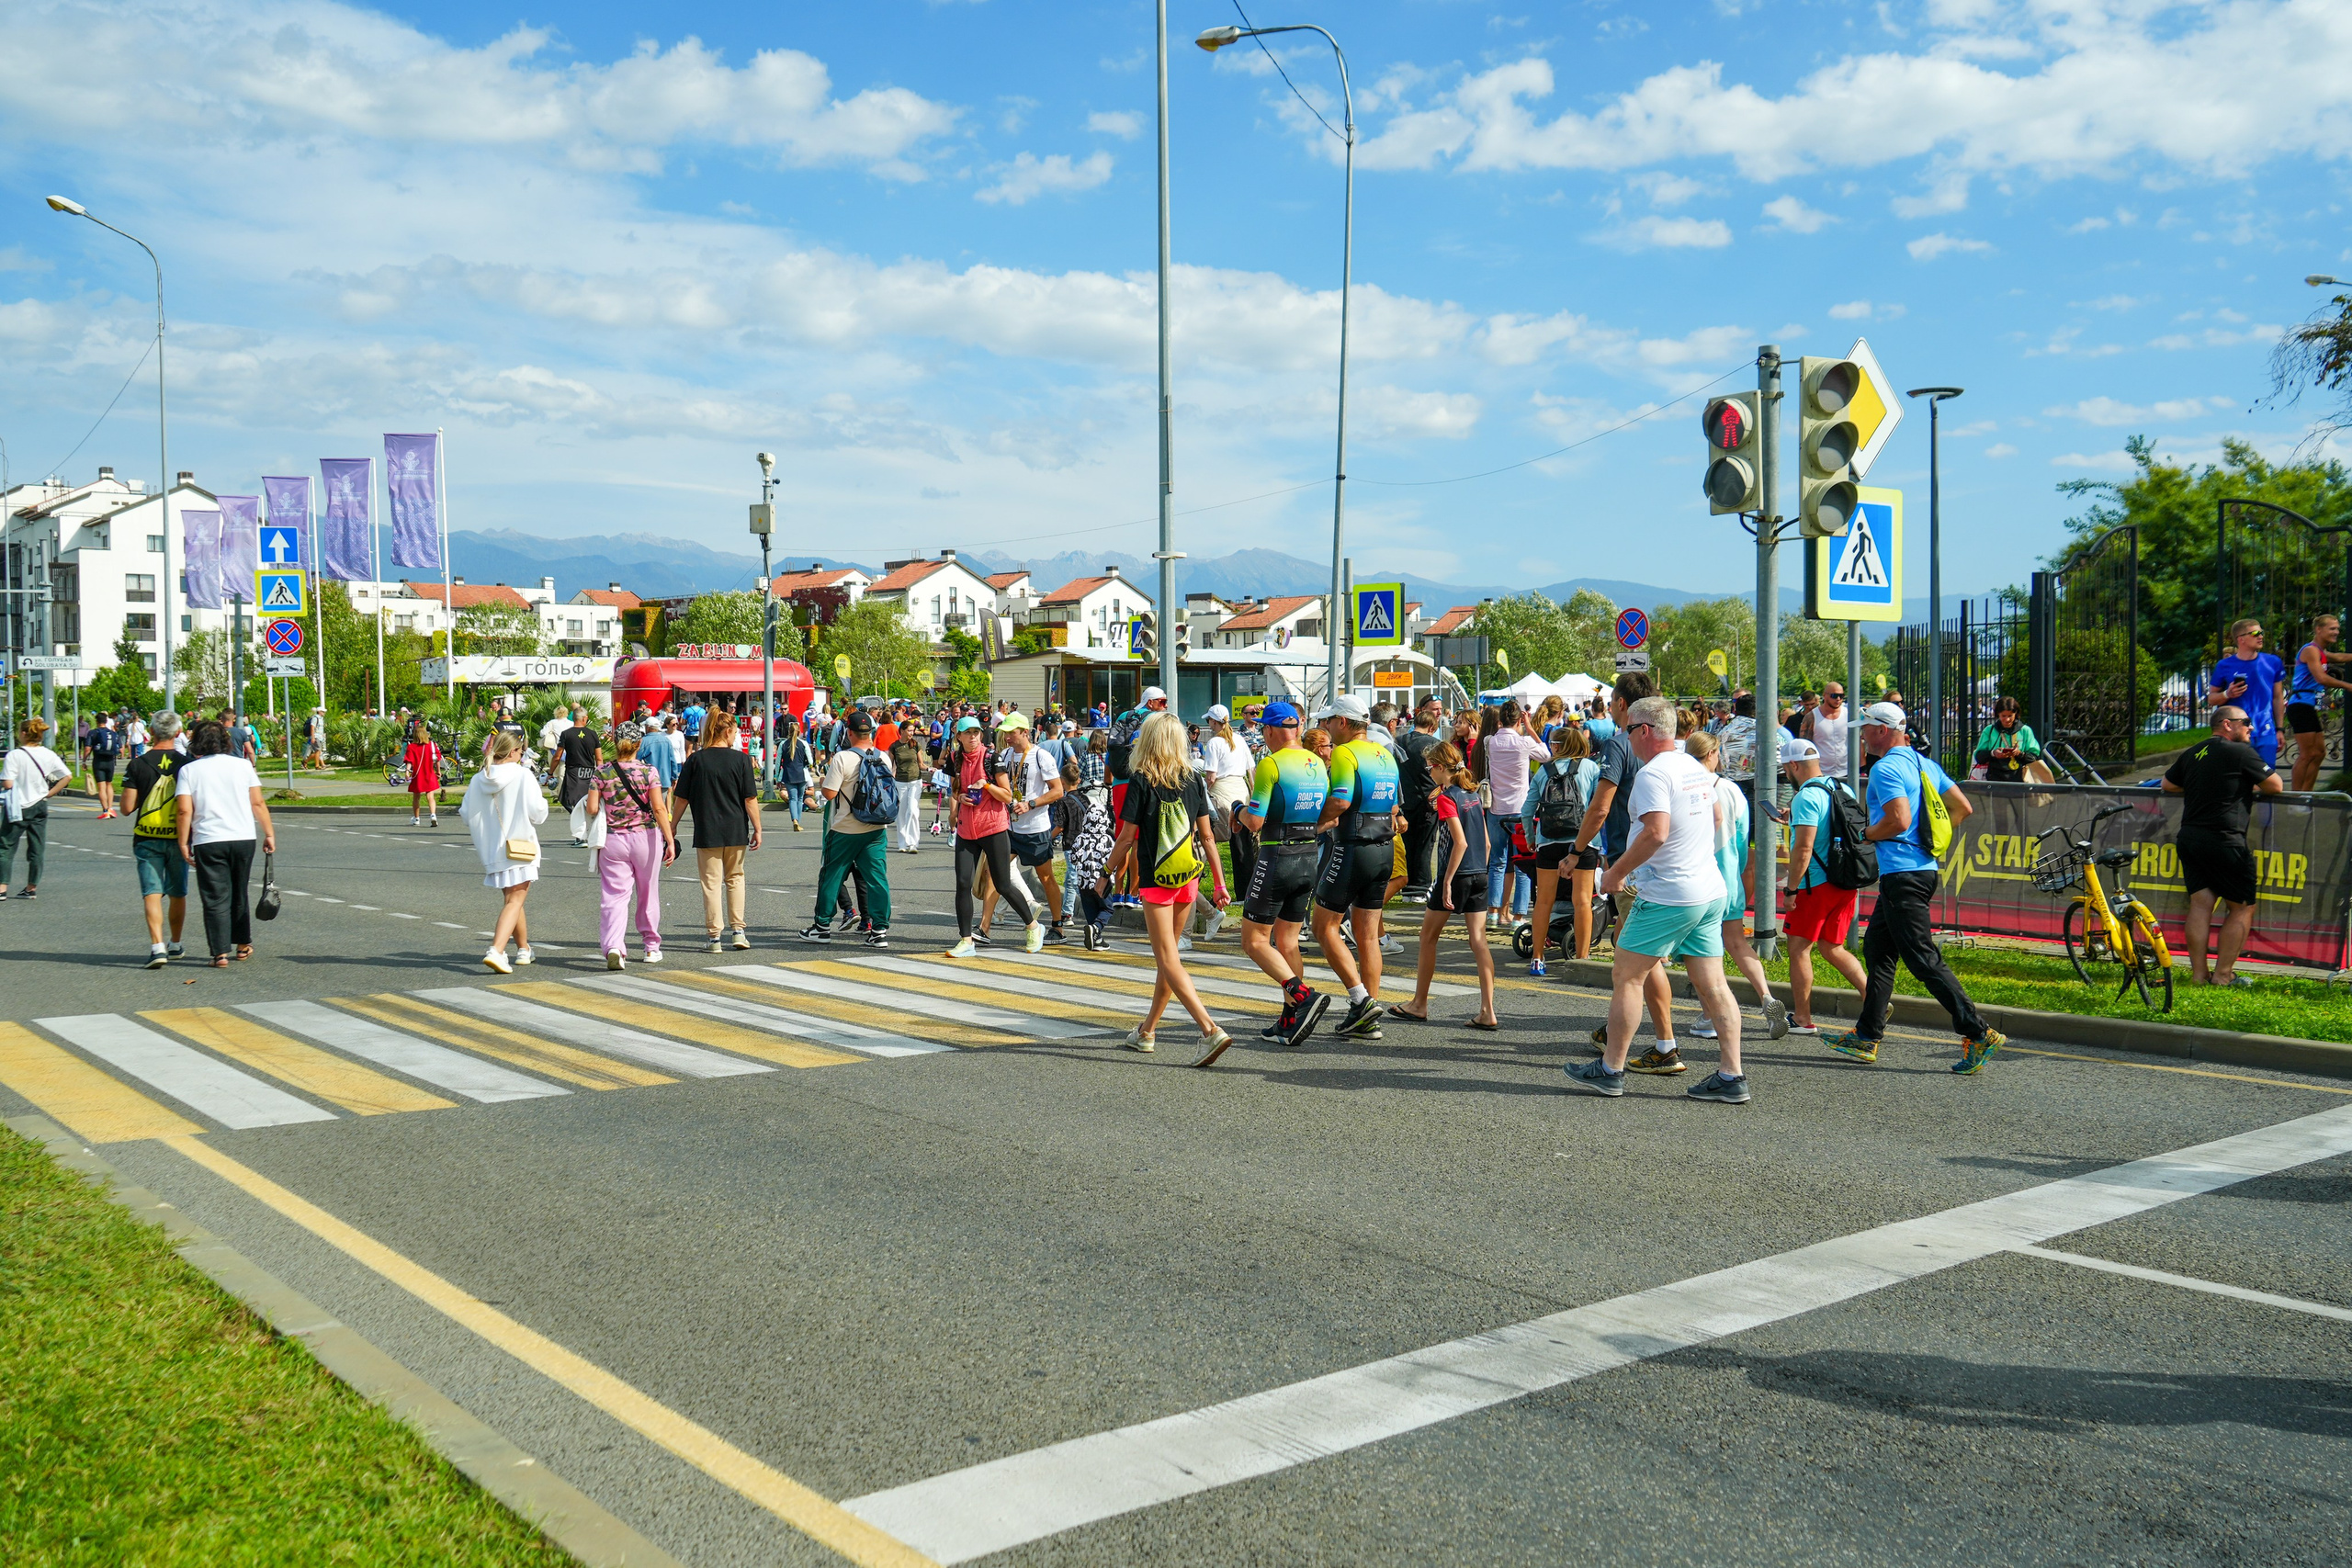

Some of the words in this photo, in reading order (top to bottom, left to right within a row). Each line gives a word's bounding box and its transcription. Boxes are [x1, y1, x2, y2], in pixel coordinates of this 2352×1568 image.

[677, 643, 699, 658] ZA
[525, 662, 585, 676] ГОЛЬФ
[1295, 801, 1315, 810] GROUP
[1297, 792, 1313, 801] ROAD
[1975, 833, 2041, 869] STAR
[1325, 846, 1345, 884] RUSSIA
[2131, 840, 2185, 879] IRO
[2254, 849, 2308, 890] TAR
[1250, 860, 1269, 899] RUSSIA
